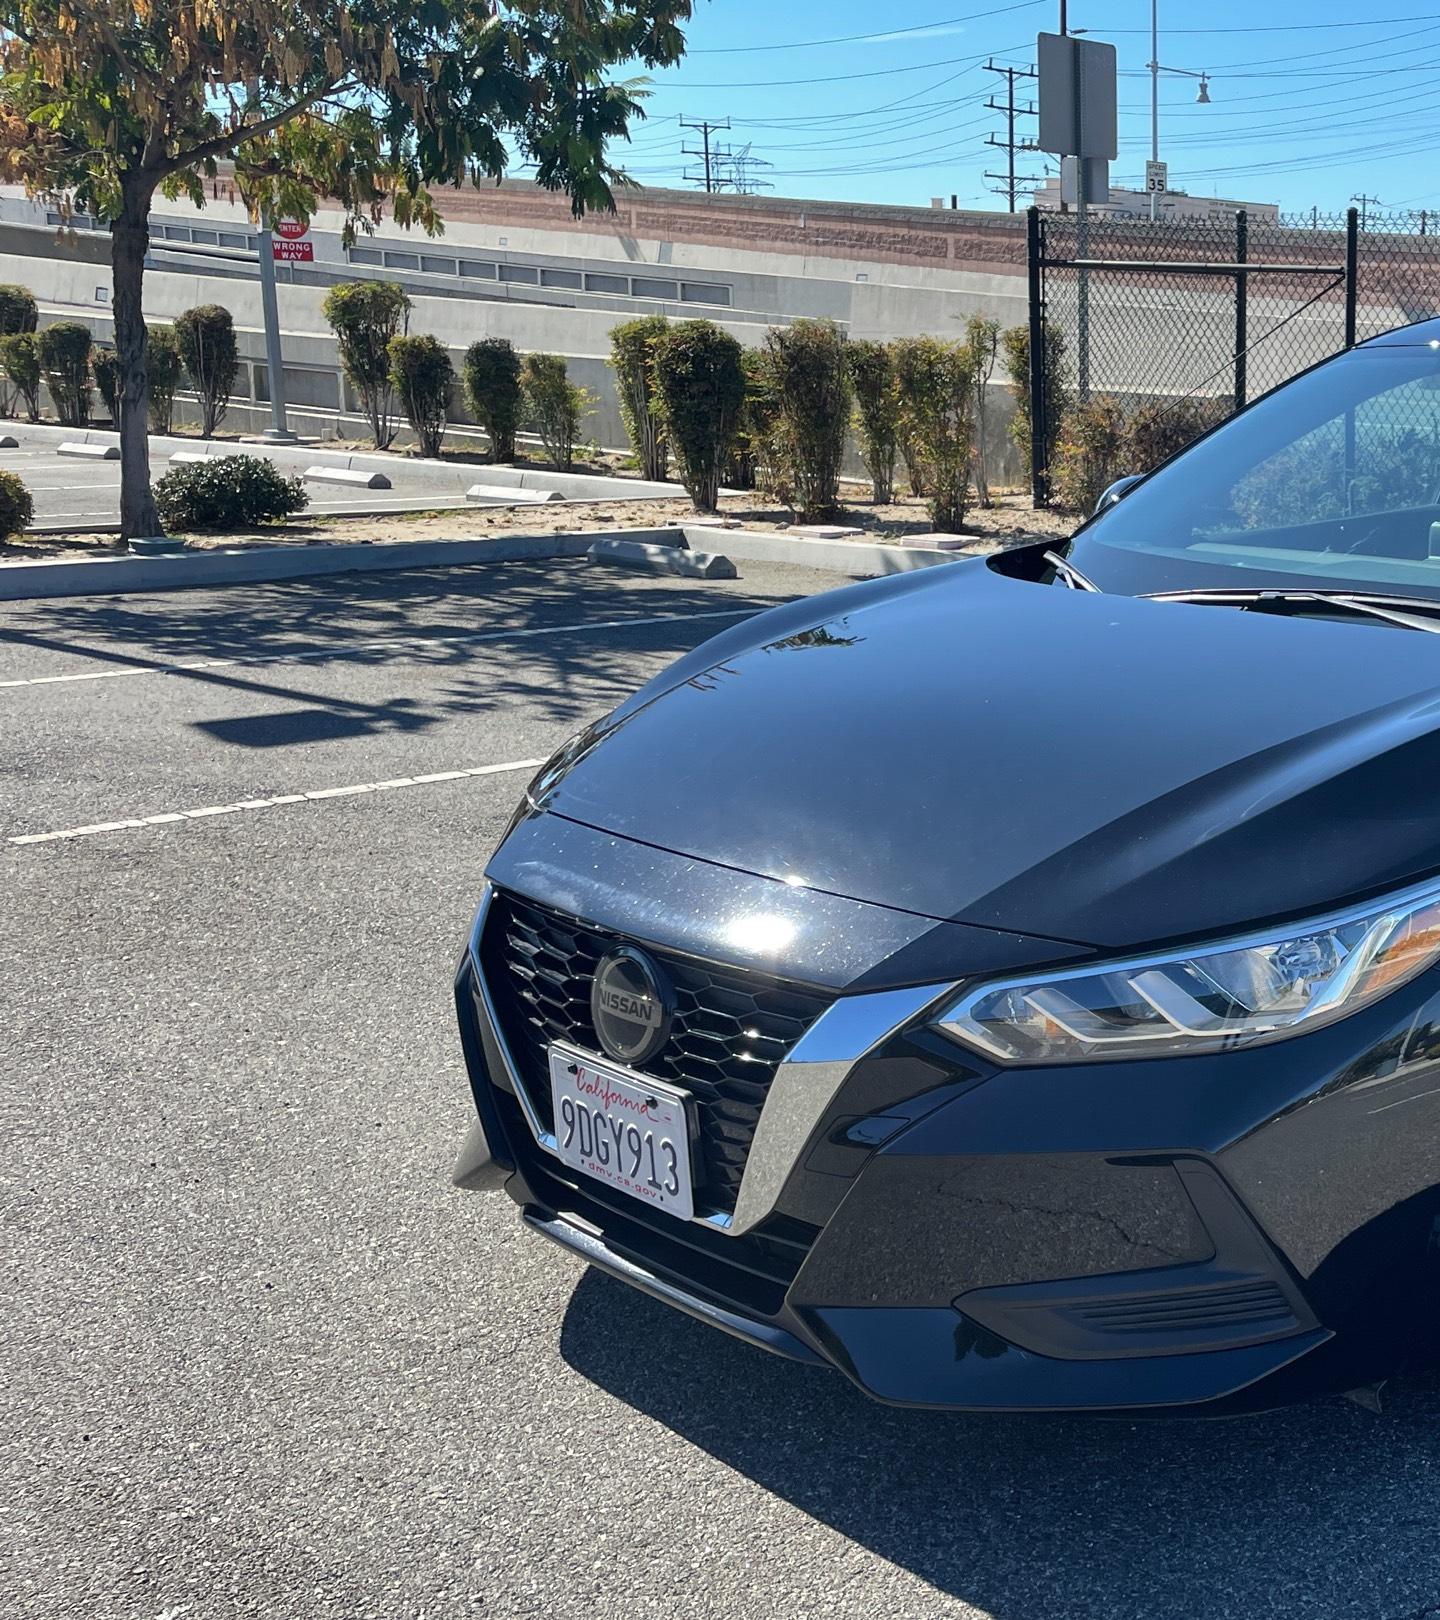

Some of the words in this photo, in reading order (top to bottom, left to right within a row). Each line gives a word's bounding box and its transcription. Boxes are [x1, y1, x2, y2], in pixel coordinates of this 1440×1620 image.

[1148, 178, 1165, 192] 35
[273, 242, 310, 251] WRONG
[281, 251, 303, 260] WAY
[600, 987, 652, 1021] NISSAN
[577, 1067, 660, 1123] California
[561, 1095, 680, 1197] 9DGY913
[588, 1162, 657, 1198] dmv.ca.gov
